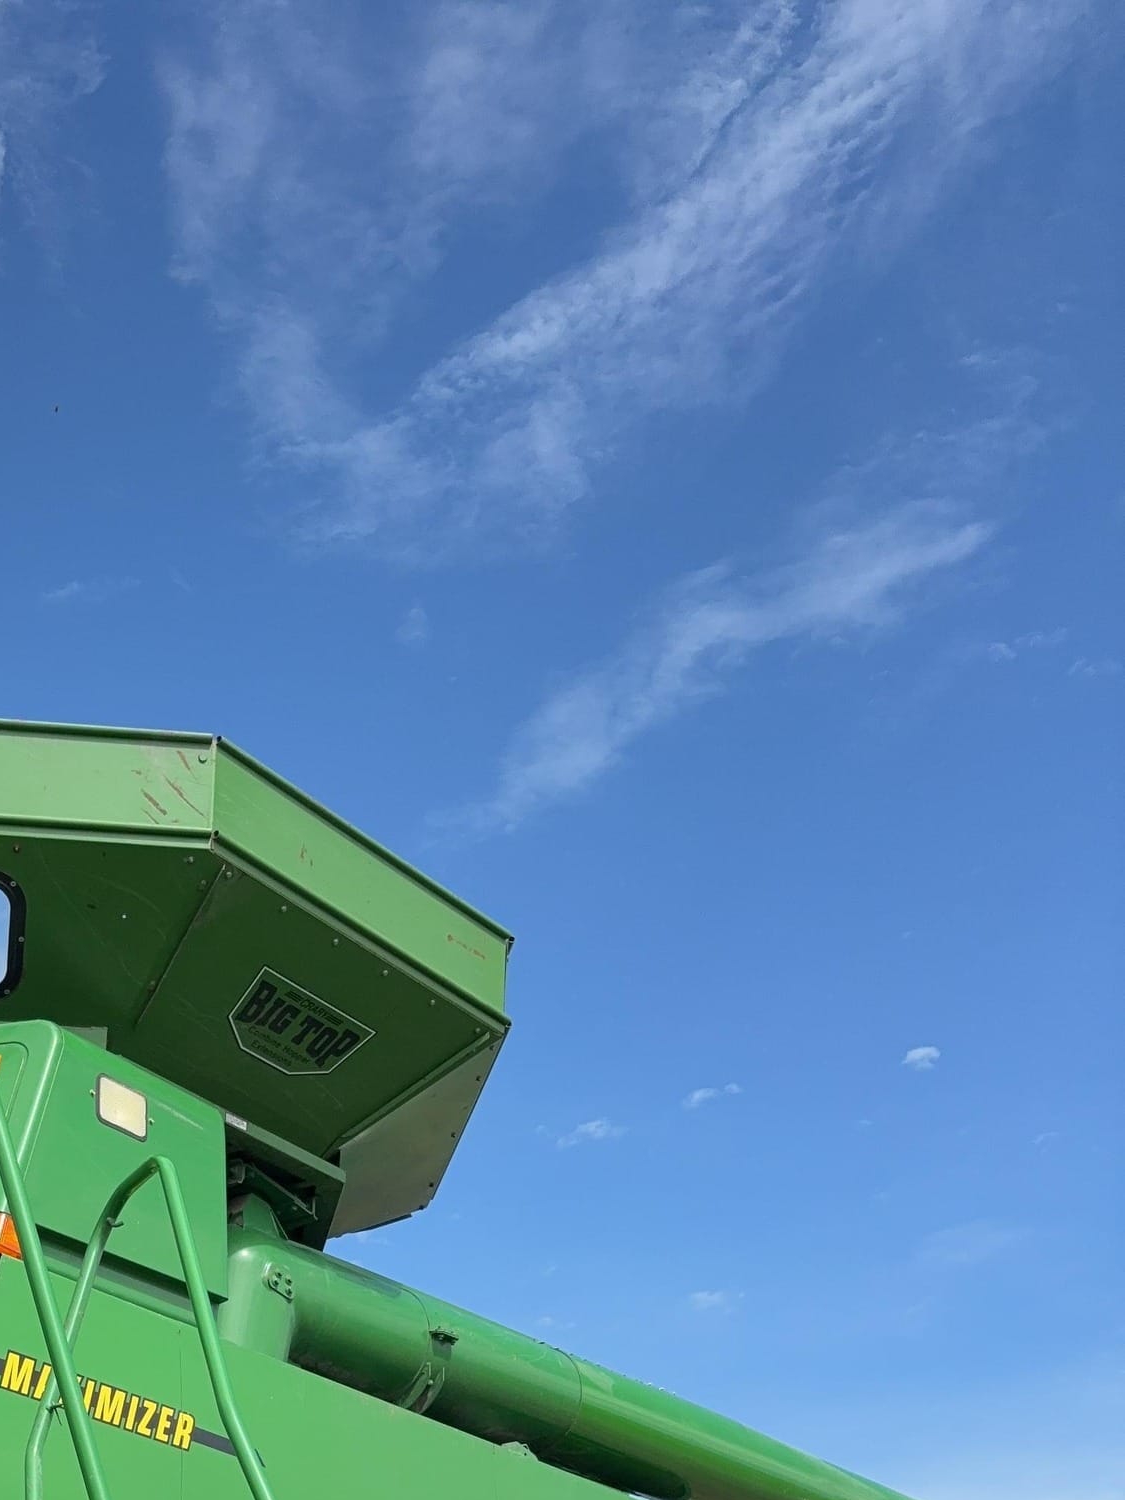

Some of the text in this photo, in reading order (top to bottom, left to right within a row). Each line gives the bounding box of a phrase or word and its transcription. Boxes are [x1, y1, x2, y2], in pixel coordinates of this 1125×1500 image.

[235, 979, 361, 1068] BIG TOP
[0, 1350, 195, 1451] MIMIZER
